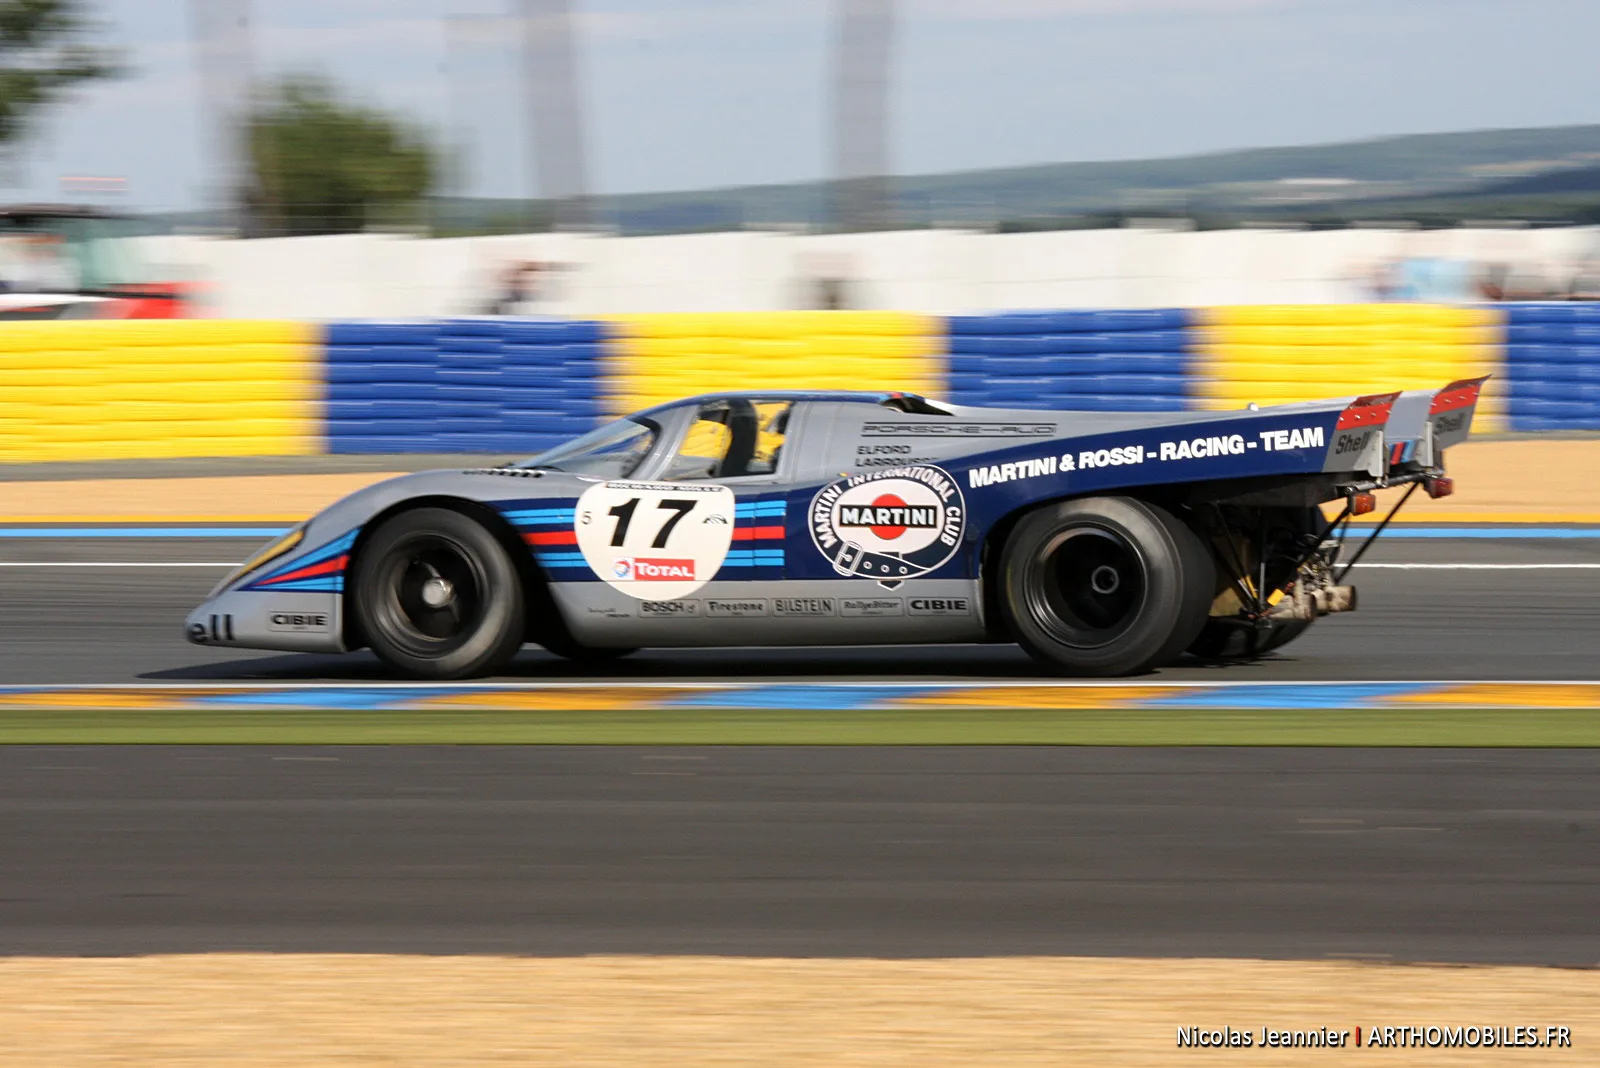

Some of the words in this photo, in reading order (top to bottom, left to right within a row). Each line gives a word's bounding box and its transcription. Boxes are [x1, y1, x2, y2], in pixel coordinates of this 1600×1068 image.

[857, 445, 911, 455] ELFORD
[1335, 430, 1371, 455] Shell
[968, 456, 1056, 488] MARTINI
[1059, 454, 1076, 472] &
[1078, 445, 1143, 469] ROSSI
[1160, 434, 1244, 461] RACING
[1260, 426, 1324, 452] TEAM
[814, 484, 842, 549] MARTINI
[847, 466, 955, 503] INTERNATIONAL
[940, 506, 961, 547] CLUB
[607, 497, 699, 549] 17
[841, 508, 935, 525] MARTINI
[635, 562, 694, 578] TOTAL
[642, 602, 684, 612] BOSCH
[708, 601, 763, 611] Firestone
[776, 599, 832, 612] BILSTEIN
[910, 600, 967, 610] CIBIE
[190, 613, 236, 643] ell
[271, 614, 328, 626] CIBIE
